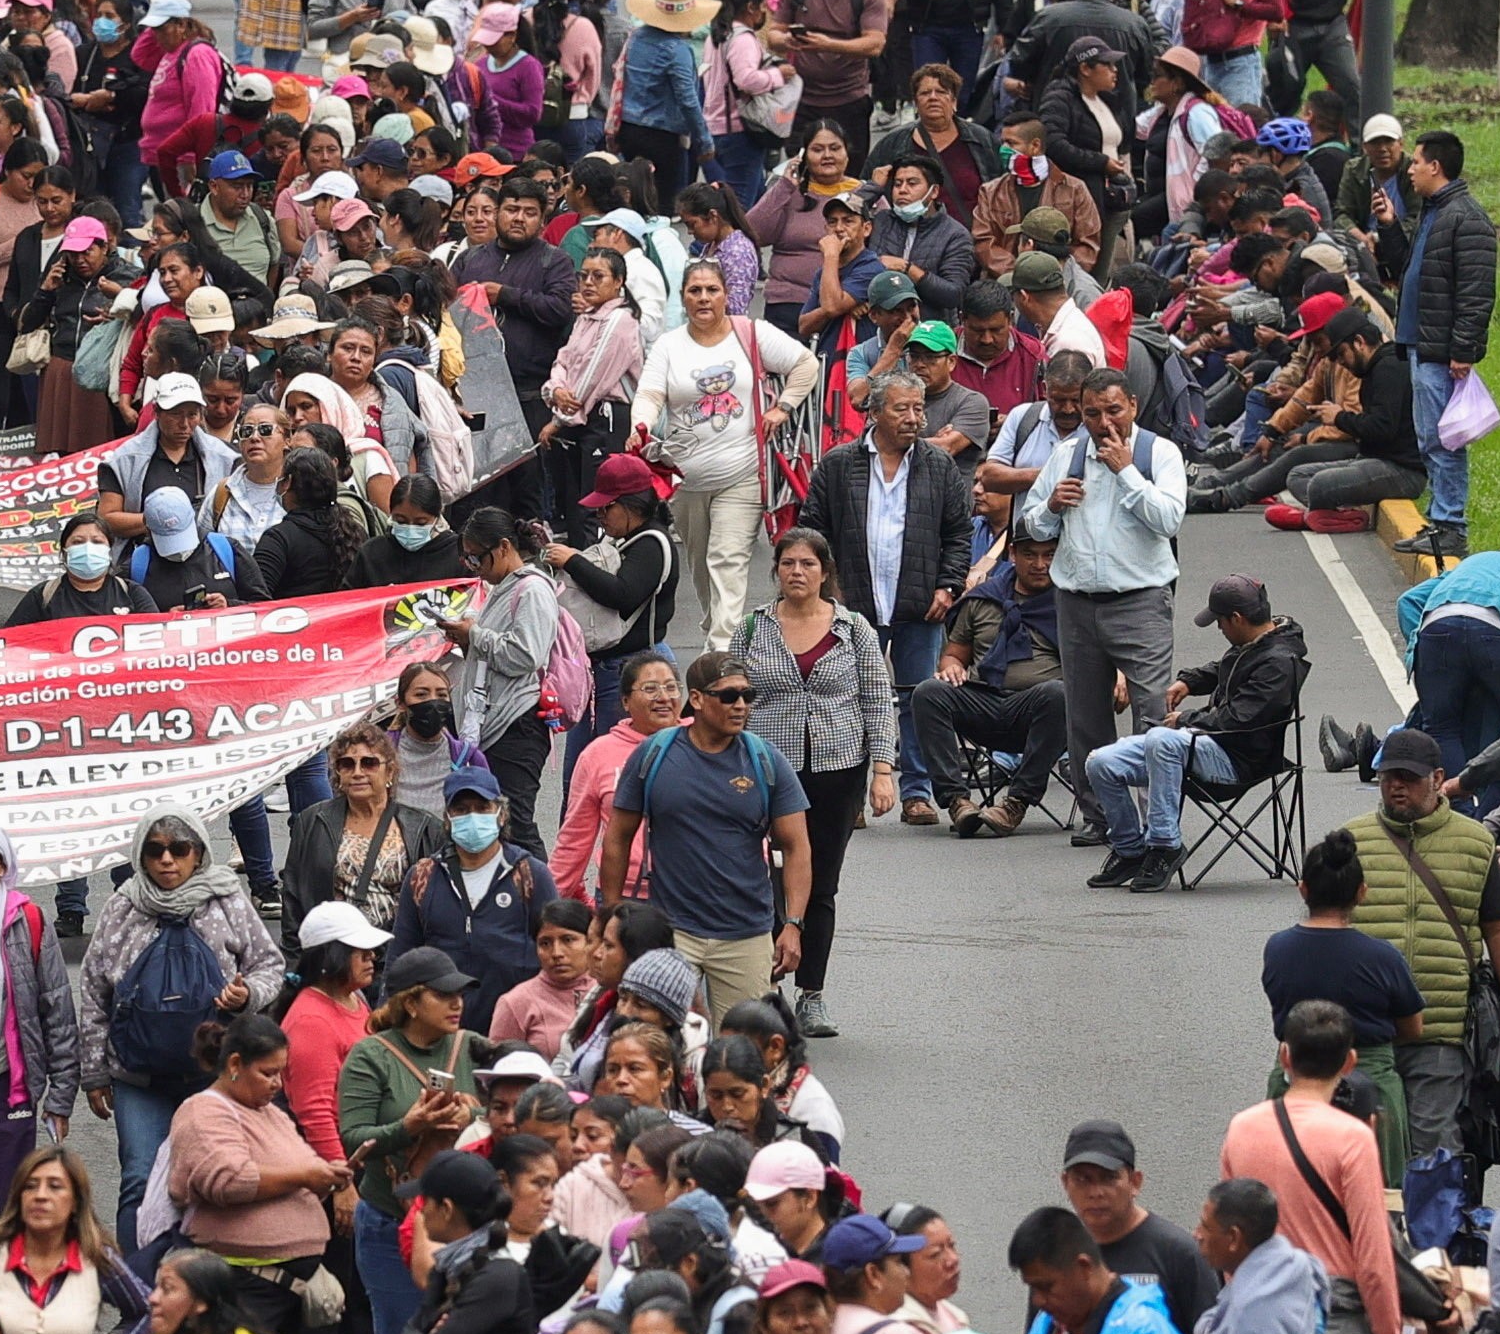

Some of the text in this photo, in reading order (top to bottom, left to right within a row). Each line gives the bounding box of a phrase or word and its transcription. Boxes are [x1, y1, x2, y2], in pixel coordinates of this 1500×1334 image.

[72, 606, 310, 658] CETEG
[42, 661, 72, 680] de
[80, 657, 115, 676] los
[126, 645, 279, 673] Trabajadores
[286, 642, 315, 664] de
[322, 642, 344, 662] la
[77, 676, 186, 700] Guerrero
[5, 707, 195, 756] D-1-443
[17, 768, 58, 789] LA
[68, 761, 130, 785] LEY
[142, 755, 204, 778] DEL
[215, 728, 328, 766] ISSSTE
[8, 804, 99, 825] PARA
[7, 1110, 33, 1120] adidas
